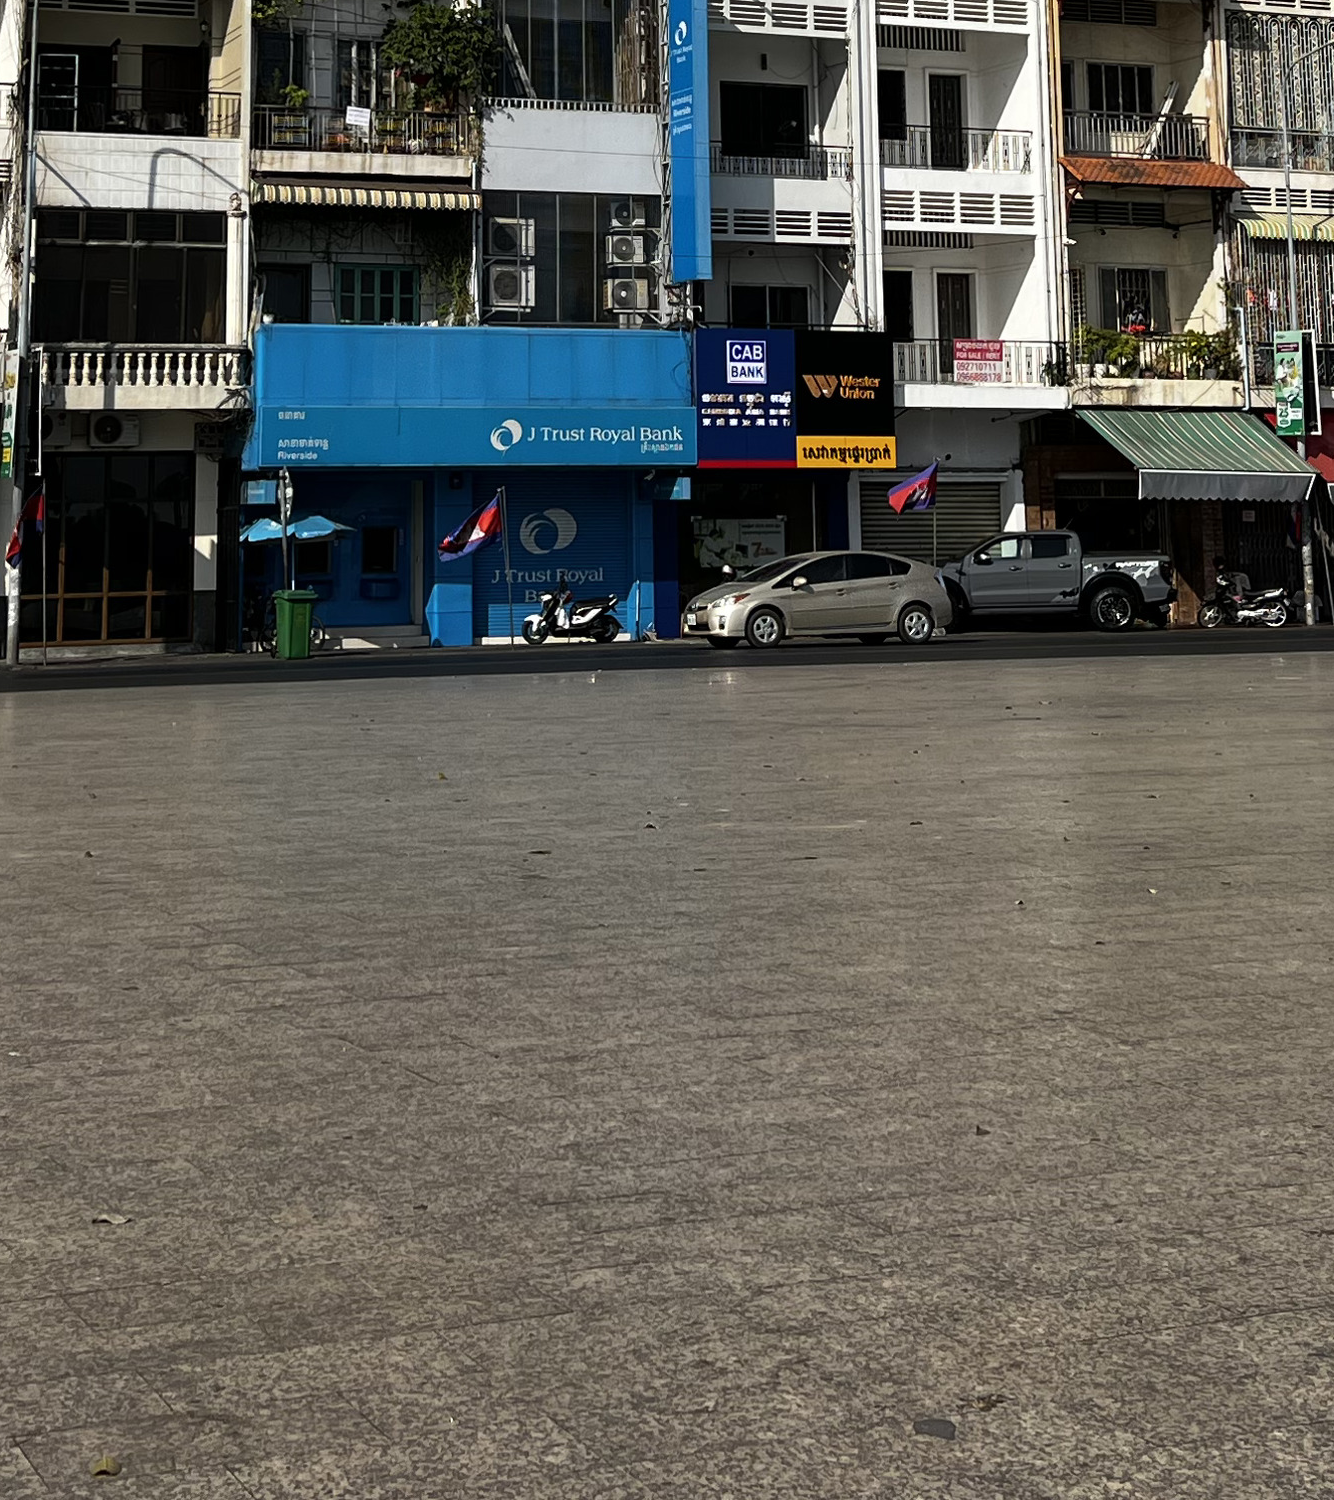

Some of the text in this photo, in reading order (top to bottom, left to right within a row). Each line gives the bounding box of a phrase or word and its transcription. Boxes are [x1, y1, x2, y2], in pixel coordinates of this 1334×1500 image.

[731, 344, 763, 360] CAB
[731, 366, 764, 378] BANK
[839, 387, 875, 399] Union
[527, 426, 683, 445] J Trust Royal Bank
[278, 451, 318, 460] Riverside
[504, 569, 551, 583] Trust
[555, 567, 604, 585] Royal
